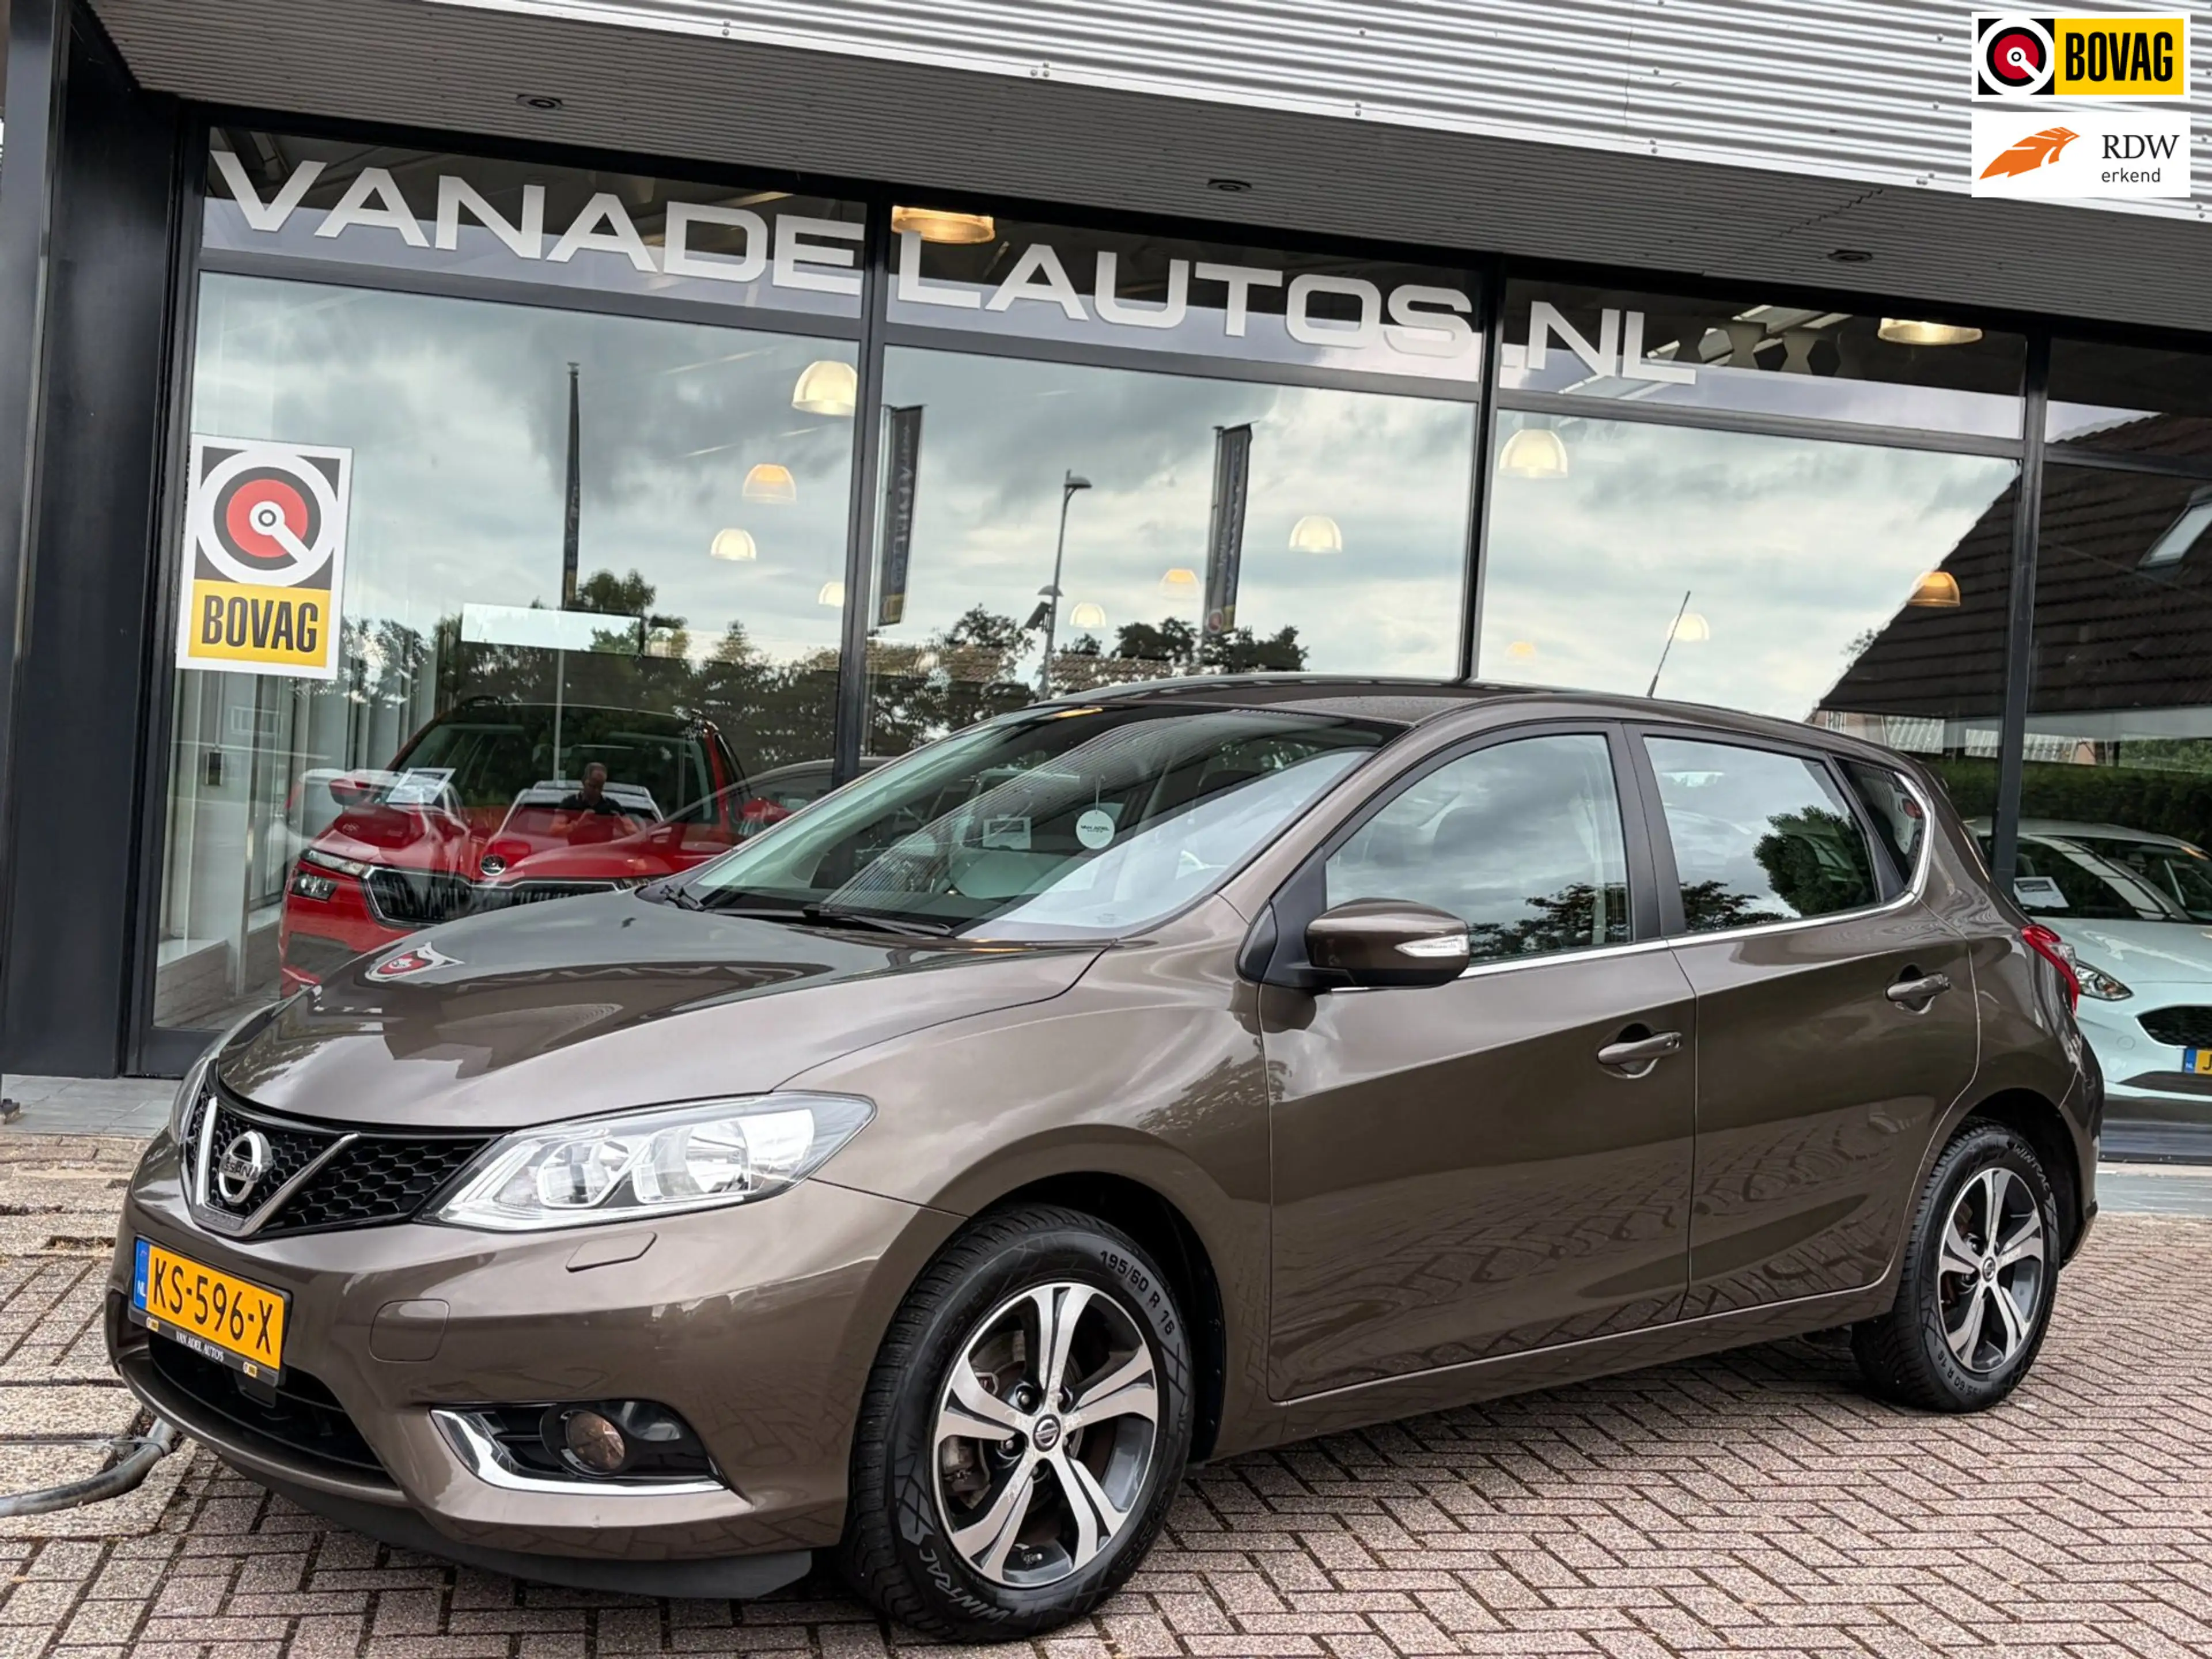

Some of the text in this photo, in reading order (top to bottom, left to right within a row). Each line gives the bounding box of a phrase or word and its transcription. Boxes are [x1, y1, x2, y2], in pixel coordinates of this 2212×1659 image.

[201, 594, 319, 653] BOVAG
[2013, 1143, 2051, 1191] WINTRAC
[137, 1257, 274, 1355] NL KS-596-X
[1100, 1250, 1175, 1335] 195/60 R 16
[203, 1343, 225, 1362] AUTOS
[1938, 1350, 1947, 1368] 16
[1947, 1367, 1955, 1379] R
[919, 1548, 1010, 1626] WINTRAC
